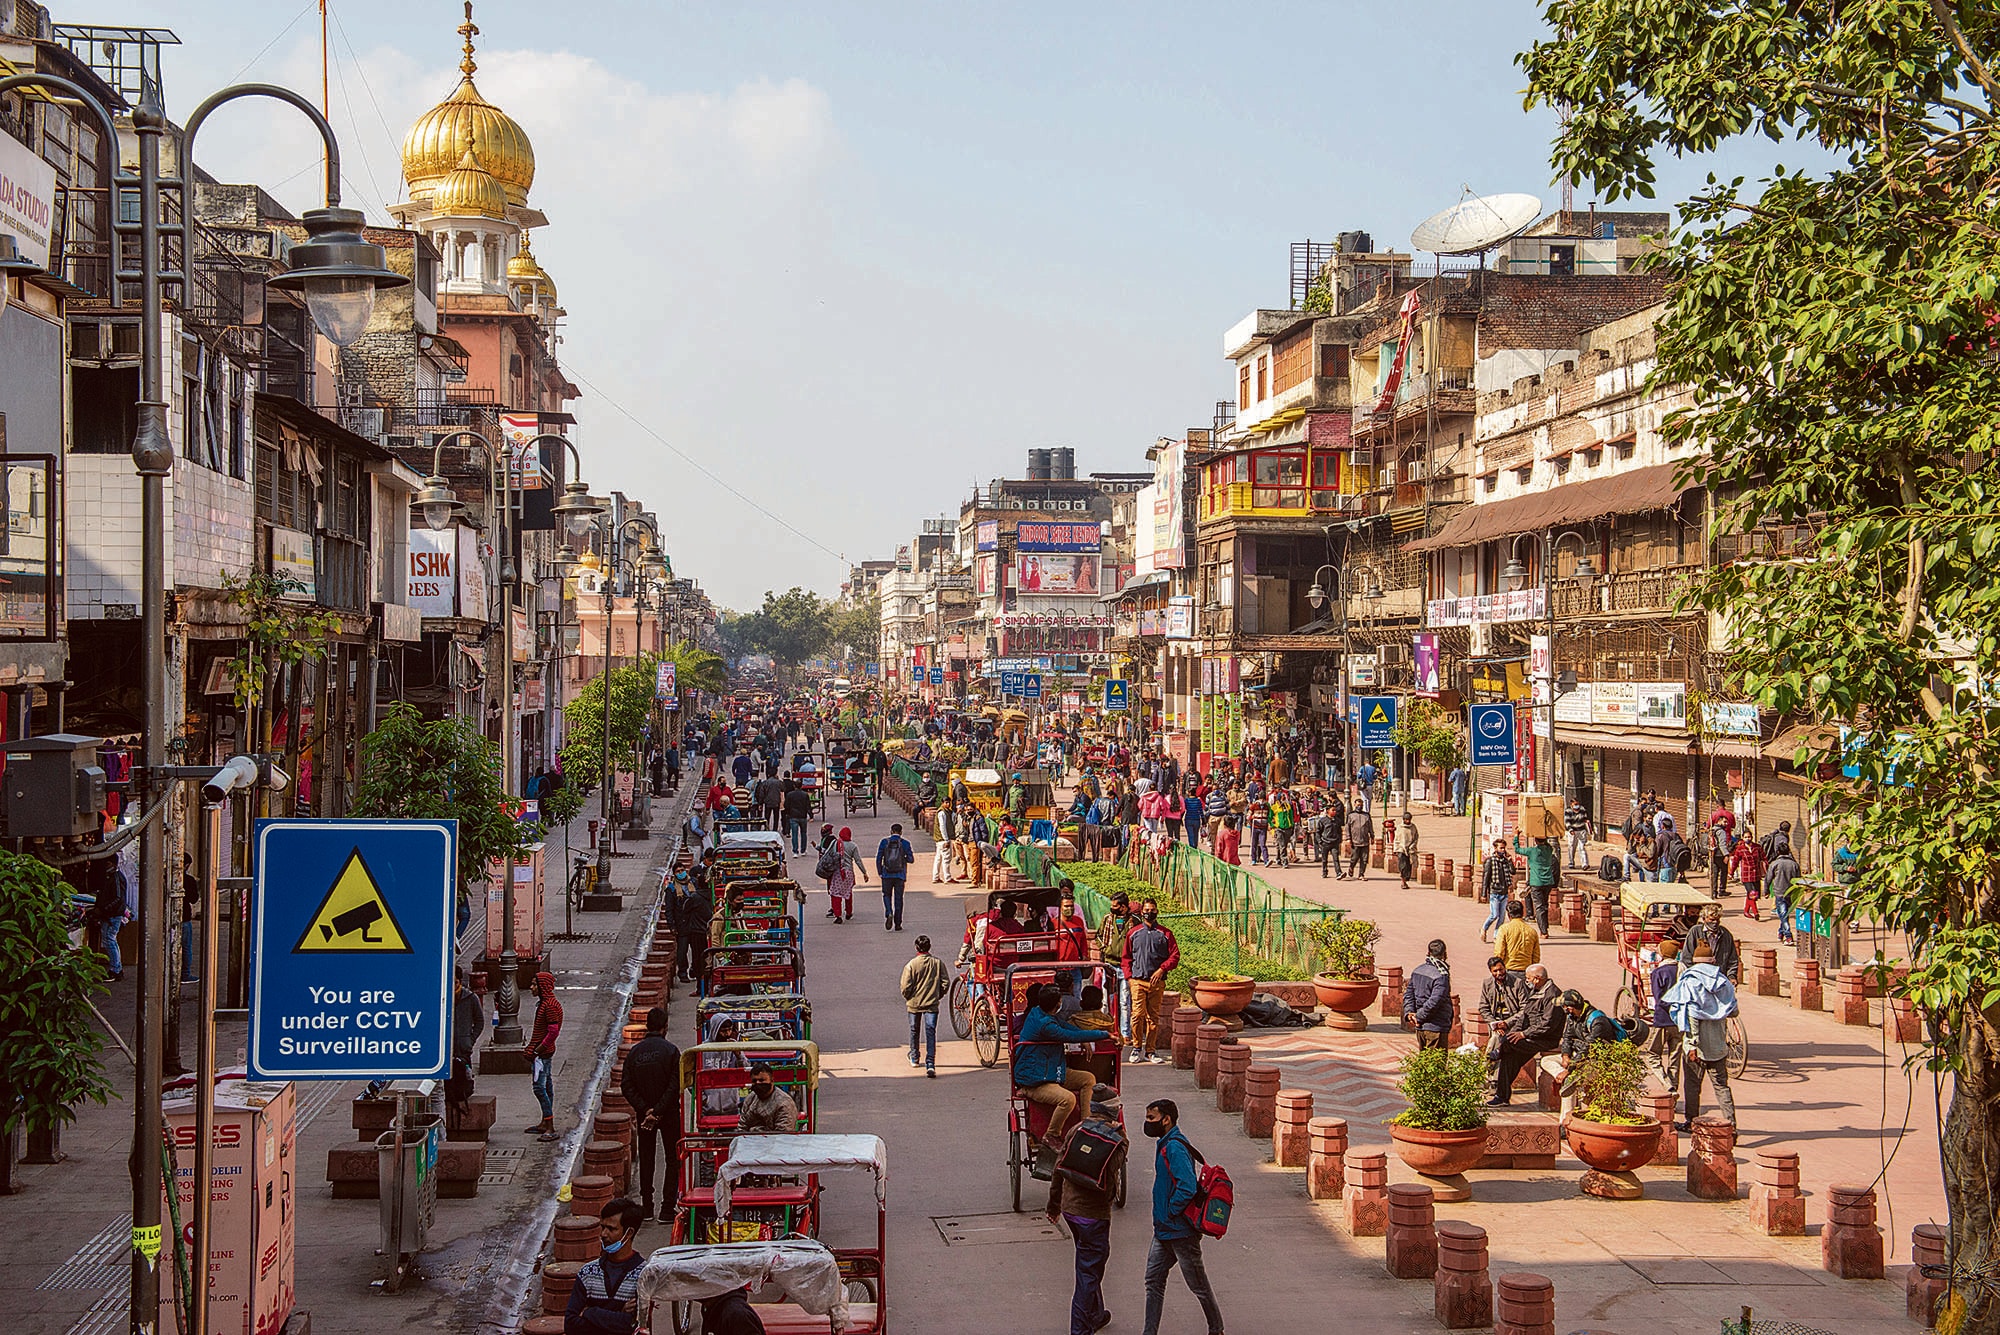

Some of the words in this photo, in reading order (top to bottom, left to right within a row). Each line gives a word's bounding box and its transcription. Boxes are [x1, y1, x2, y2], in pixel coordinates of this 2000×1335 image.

[0, 174, 14, 208] DA
[16, 186, 49, 229] STUDIO
[1019, 525, 1049, 544] SINDOOR
[1050, 525, 1071, 545] SAREE
[1072, 525, 1100, 545] KENDRA
[410, 552, 451, 577] ISHK
[308, 986, 352, 1004] You
[359, 990, 396, 1004] are
[281, 1011, 350, 1030] under
[356, 1011, 422, 1029] CCTV
[279, 1036, 422, 1055] Surveillance
[162, 1124, 241, 1145] BSS
[211, 1166, 242, 1175] DELHI
[132, 1231, 146, 1240] SH
[149, 1229, 161, 1239] LO
